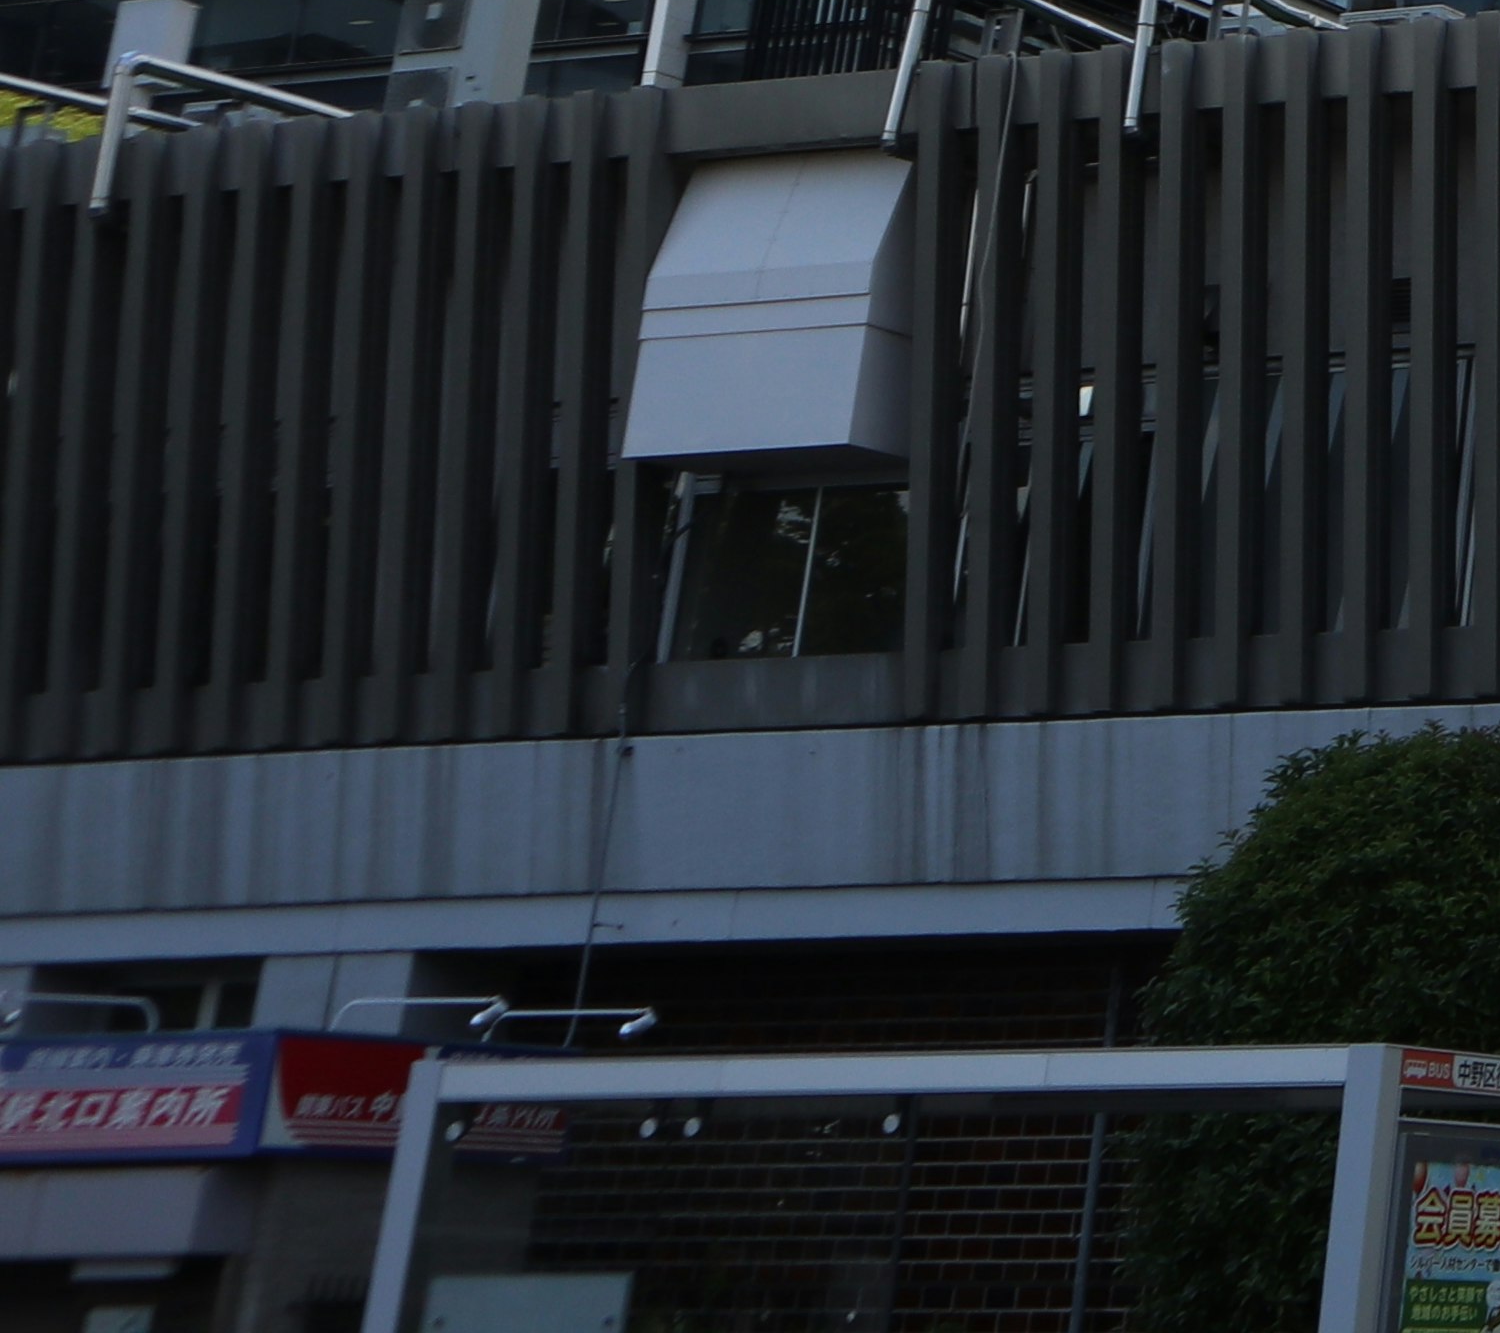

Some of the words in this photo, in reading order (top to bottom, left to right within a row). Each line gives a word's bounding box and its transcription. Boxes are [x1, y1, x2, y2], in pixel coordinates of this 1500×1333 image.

[1428, 1062, 1451, 1079] BUS
[0, 1088, 231, 1134] 駅北口案内所
